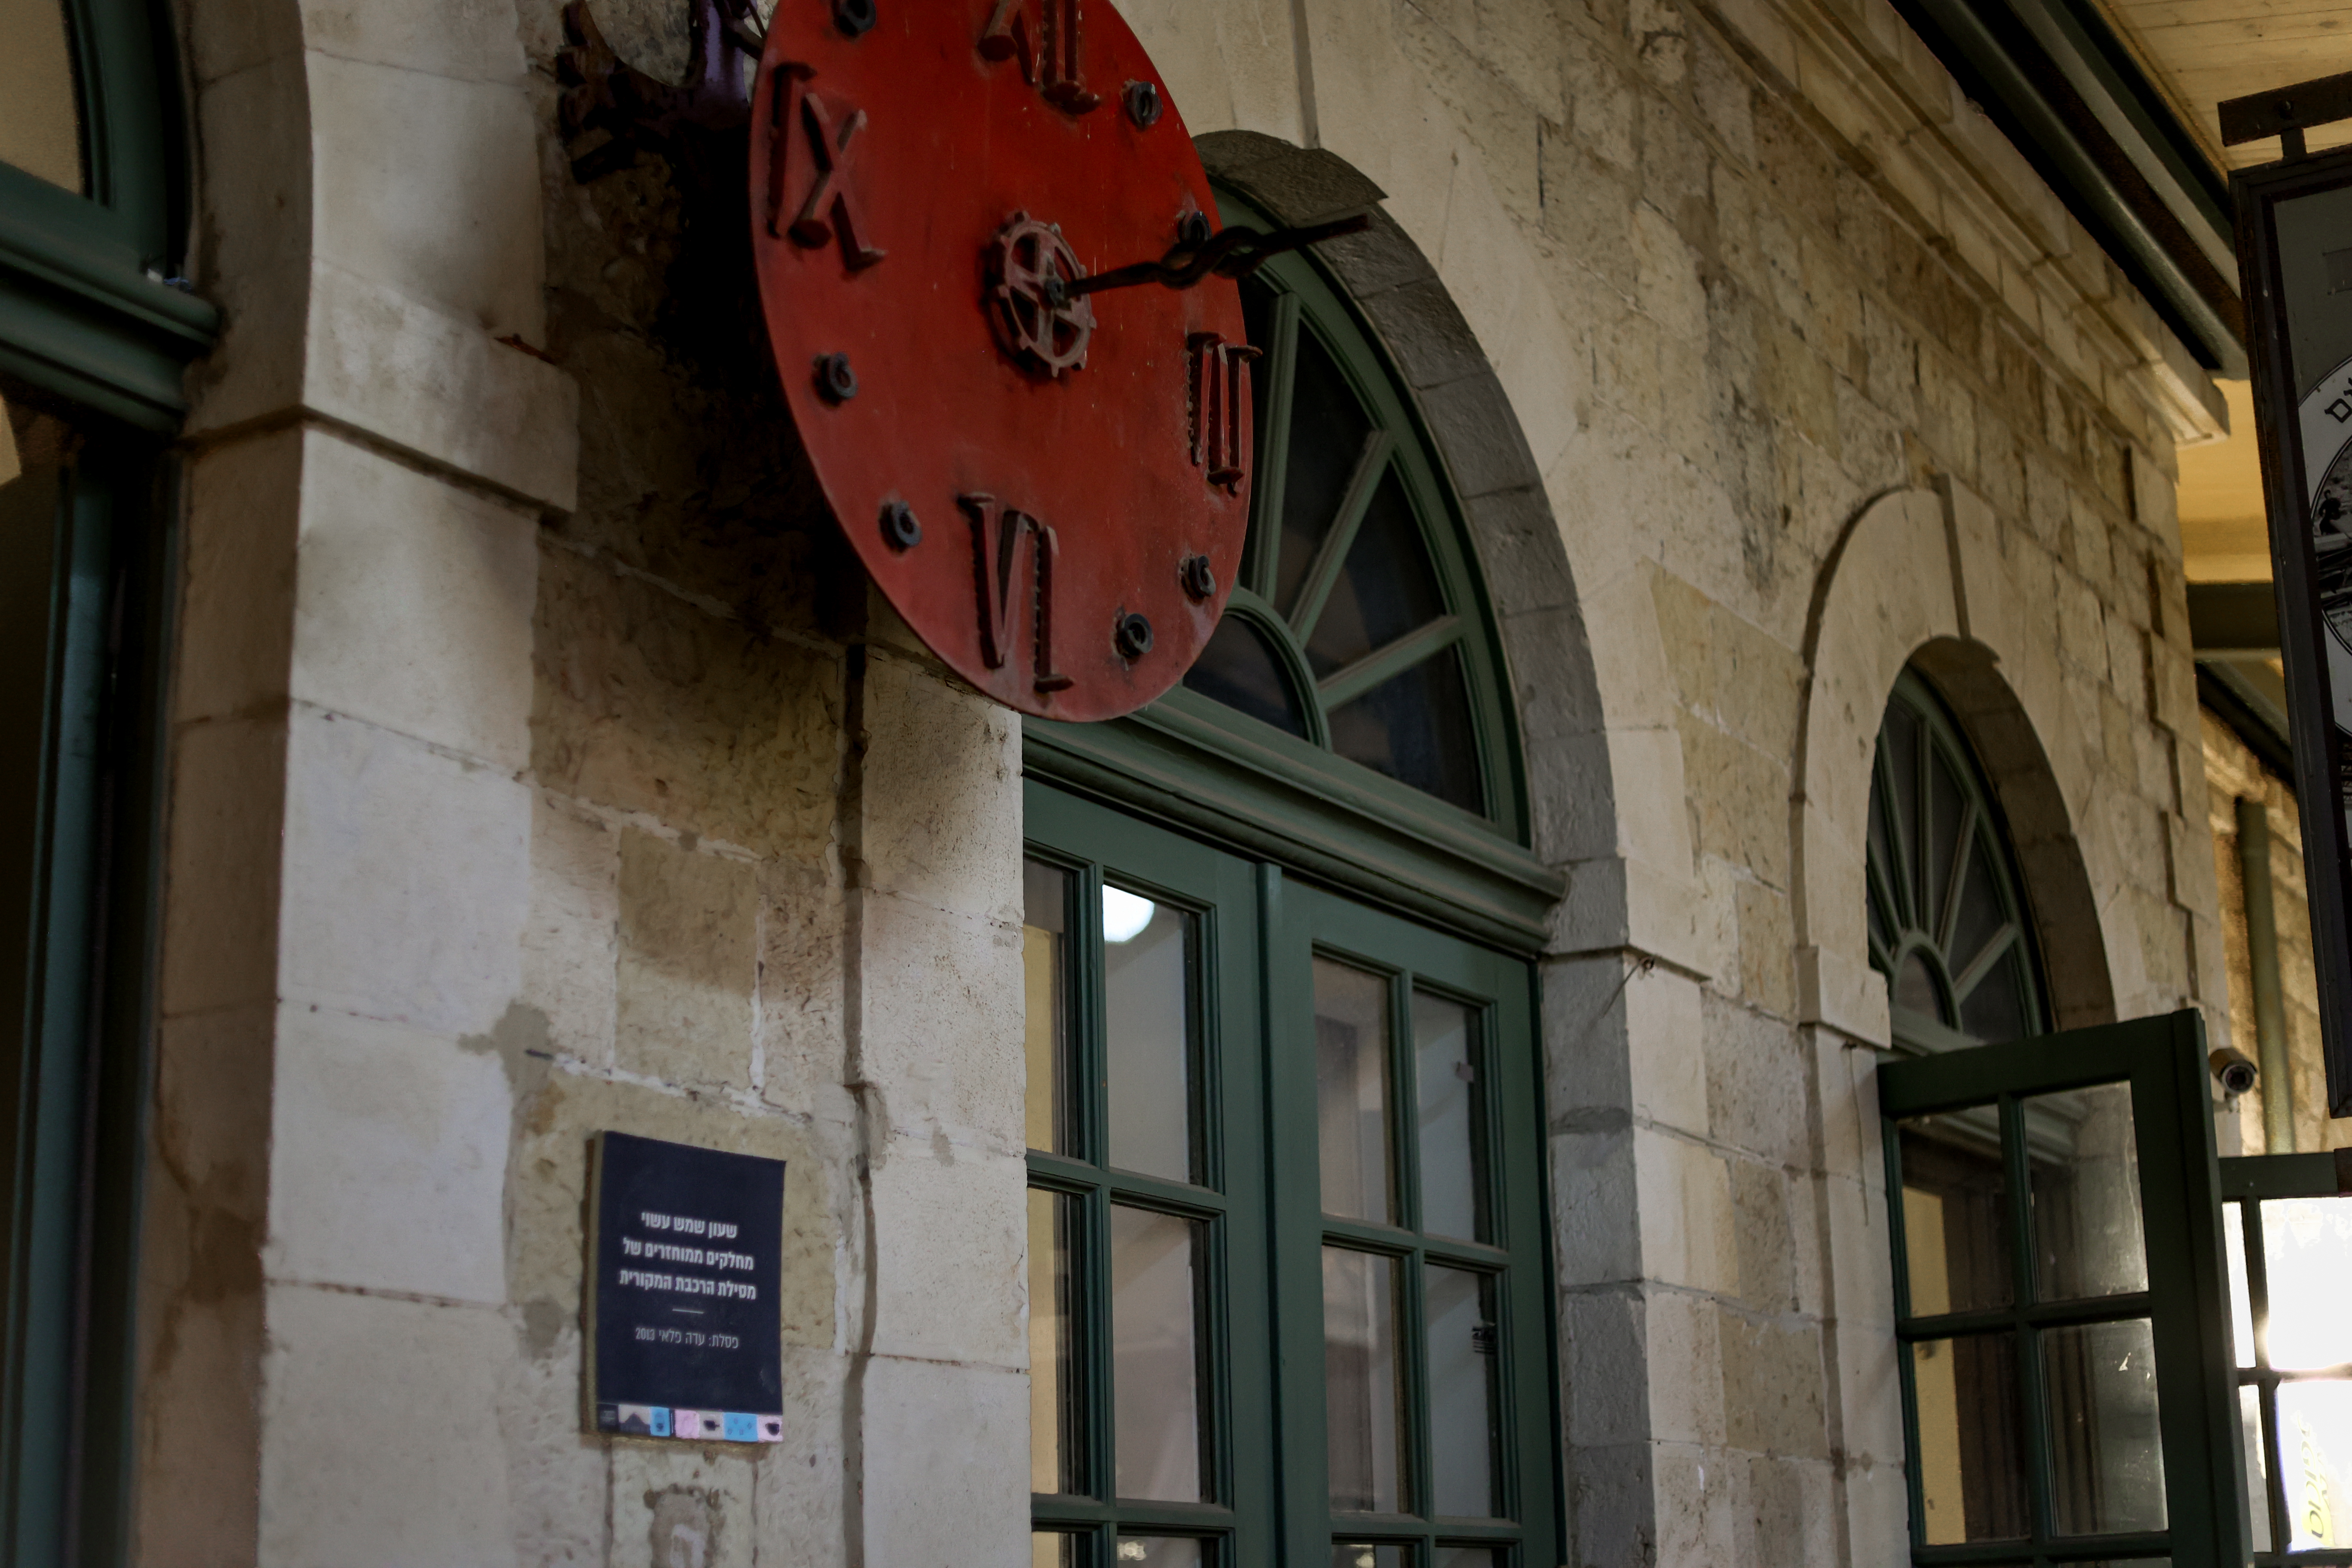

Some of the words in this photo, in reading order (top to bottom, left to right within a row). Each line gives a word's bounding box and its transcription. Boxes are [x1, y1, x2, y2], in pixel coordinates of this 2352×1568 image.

[767, 61, 888, 272] IX
[1186, 331, 1262, 496] III
[957, 493, 1074, 693] VI
[641, 1212, 671, 1229] עשוי
[674, 1216, 705, 1234] שמש
[708, 1221, 738, 1239] שעון
[623, 1237, 642, 1256] של
[645, 1242, 704, 1264] ממוחזרים
[706, 1250, 754, 1270] מחלקים
[619, 1270, 672, 1290] המקורית
[675, 1277, 715, 1295] הרכבת
[717, 1280, 756, 1300] מסילת
[658, 1329, 681, 1343] פלאי
[685, 1332, 705, 1346] עדה
[709, 1333, 739, 1348] פסלת:
